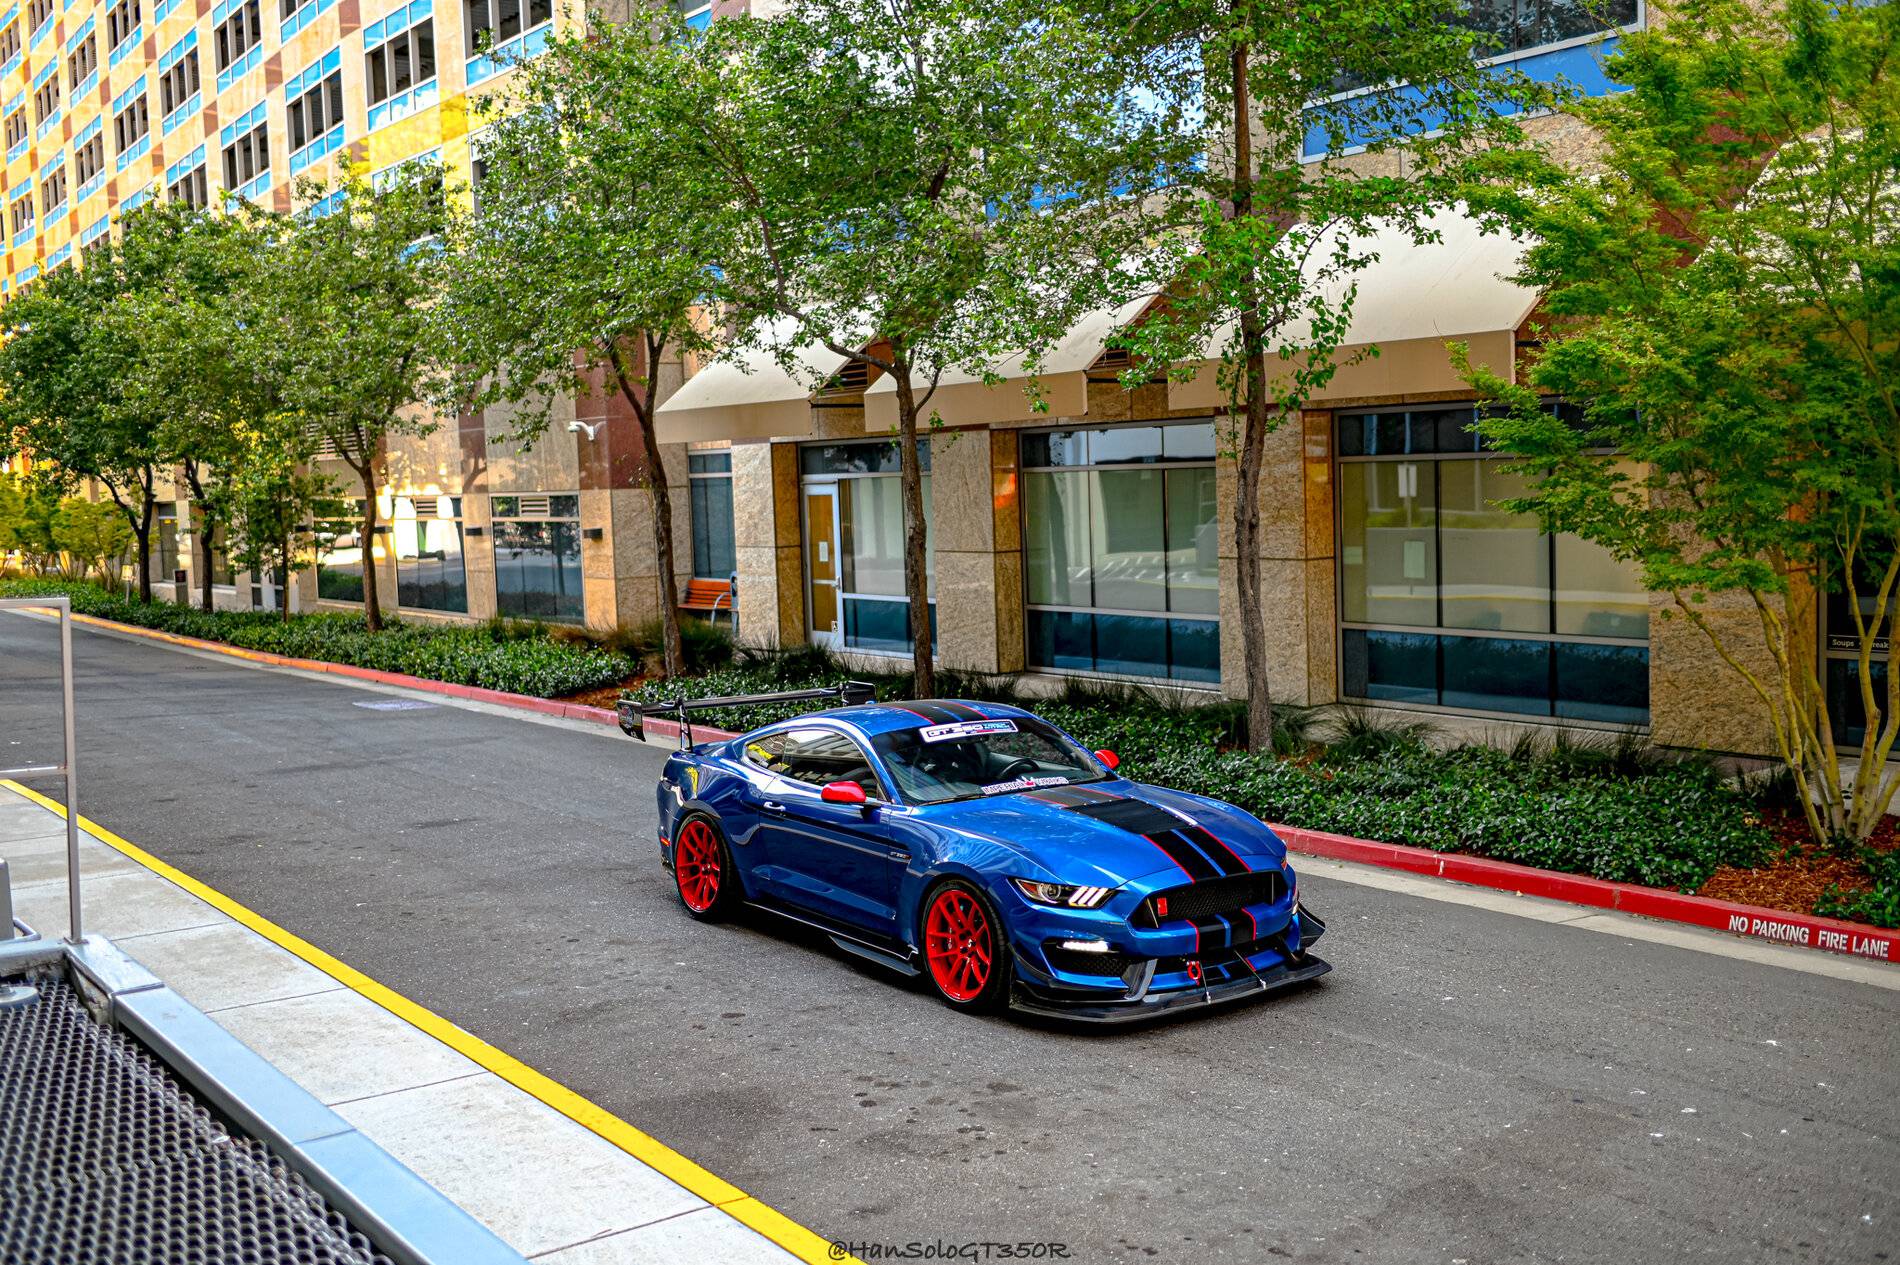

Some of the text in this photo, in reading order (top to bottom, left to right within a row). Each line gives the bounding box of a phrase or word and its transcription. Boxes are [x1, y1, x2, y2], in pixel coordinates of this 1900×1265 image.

[1832, 639, 1855, 648] Soups
[1728, 914, 1889, 958] NO PARKING FIRE LANE
